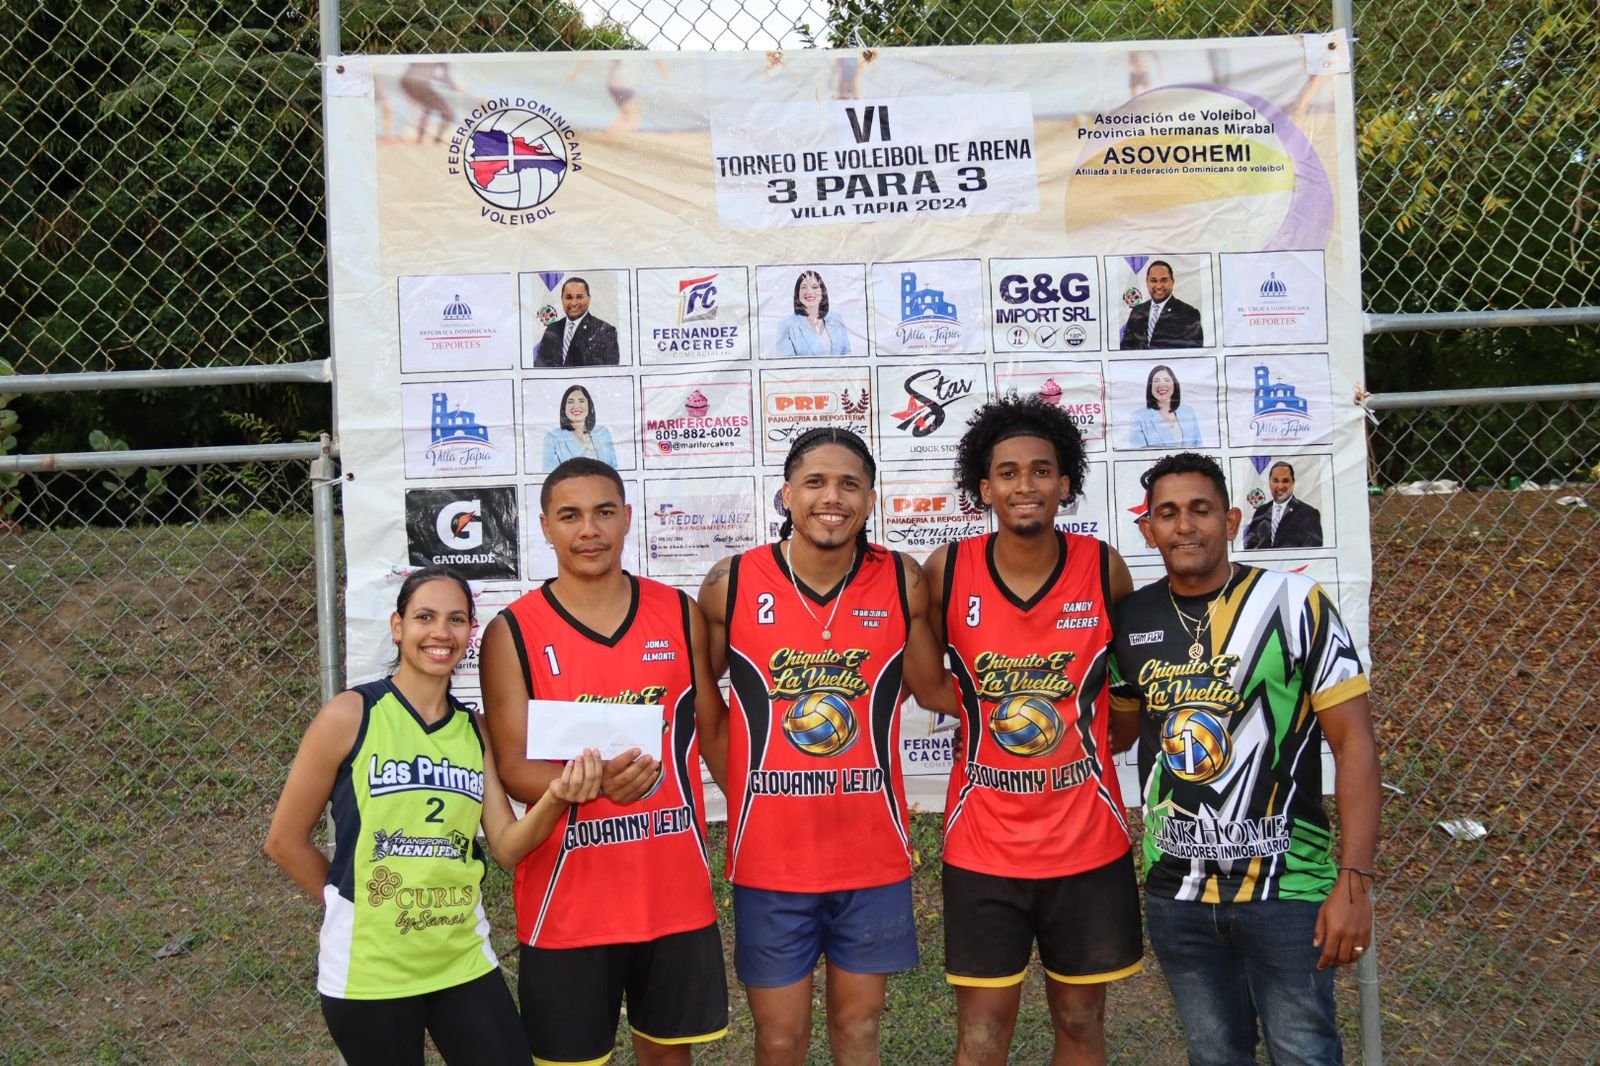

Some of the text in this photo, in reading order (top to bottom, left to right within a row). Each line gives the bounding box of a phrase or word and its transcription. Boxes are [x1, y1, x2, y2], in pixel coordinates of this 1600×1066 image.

[845, 105, 892, 144] VI
[1094, 109, 1256, 125] Asociación de Voleibol
[448, 97, 582, 175] FEDERACION DOMINICANA
[1078, 122, 1275, 139] Provincia hermanas Mirabal
[717, 138, 1032, 177] TORNEO DE VOLEIBOL DE ARENA
[1103, 144, 1251, 164] ASOVOHEMI
[1075, 168, 1109, 176] Afiliada
[1130, 166, 1179, 175] Federación
[1182, 165, 1234, 174] Dominicana
[1250, 164, 1285, 172] voleibol
[767, 166, 988, 204] 3 PARA 3
[481, 206, 556, 226] VOLEIBOL
[791, 197, 967, 219] VILLA TAPIA 2024
[999, 272, 1090, 304] G&G
[996, 306, 1097, 324] IMPORT SRL
[1249, 317, 1297, 326] DEPORTES
[653, 326, 739, 340] FERNANDEZ
[896, 326, 961, 345] Villa Tapia
[431, 340, 481, 350] DEPORTES
[657, 338, 735, 352] CACERES
[774, 394, 830, 411] PRF
[647, 415, 749, 430] MARIFERCAKES
[655, 427, 741, 440] 809-882-6002
[893, 496, 947, 512] PRF
[436, 498, 483, 550] G
[432, 553, 496, 565] GATORADE
[757, 592, 775, 624] 2
[966, 595, 982, 628] 3
[1062, 601, 1093, 613] RANDY
[1055, 614, 1099, 630] CÁCERES
[644, 640, 669, 649] JONAS
[544, 643, 560, 677] 1
[641, 651, 676, 662] ALMONTE
[768, 648, 841, 671] Chiquito
[974, 651, 1047, 674] Chiquito
[769, 669, 803, 696] La
[977, 671, 1005, 696] La
[1138, 658, 1210, 686] Chiquito
[1144, 681, 1170, 712] La
[1180, 729, 1196, 775] 1
[369, 754, 484, 797] Las Primas
[750, 770, 838, 797] GIOVANNY
[966, 761, 1047, 793] GIOVANNY
[424, 797, 445, 823] 2
[564, 812, 650, 852] GIOVANNY
[390, 844, 433, 857] MENA
[395, 884, 473, 910] CURLS
[395, 910, 415, 935] by
